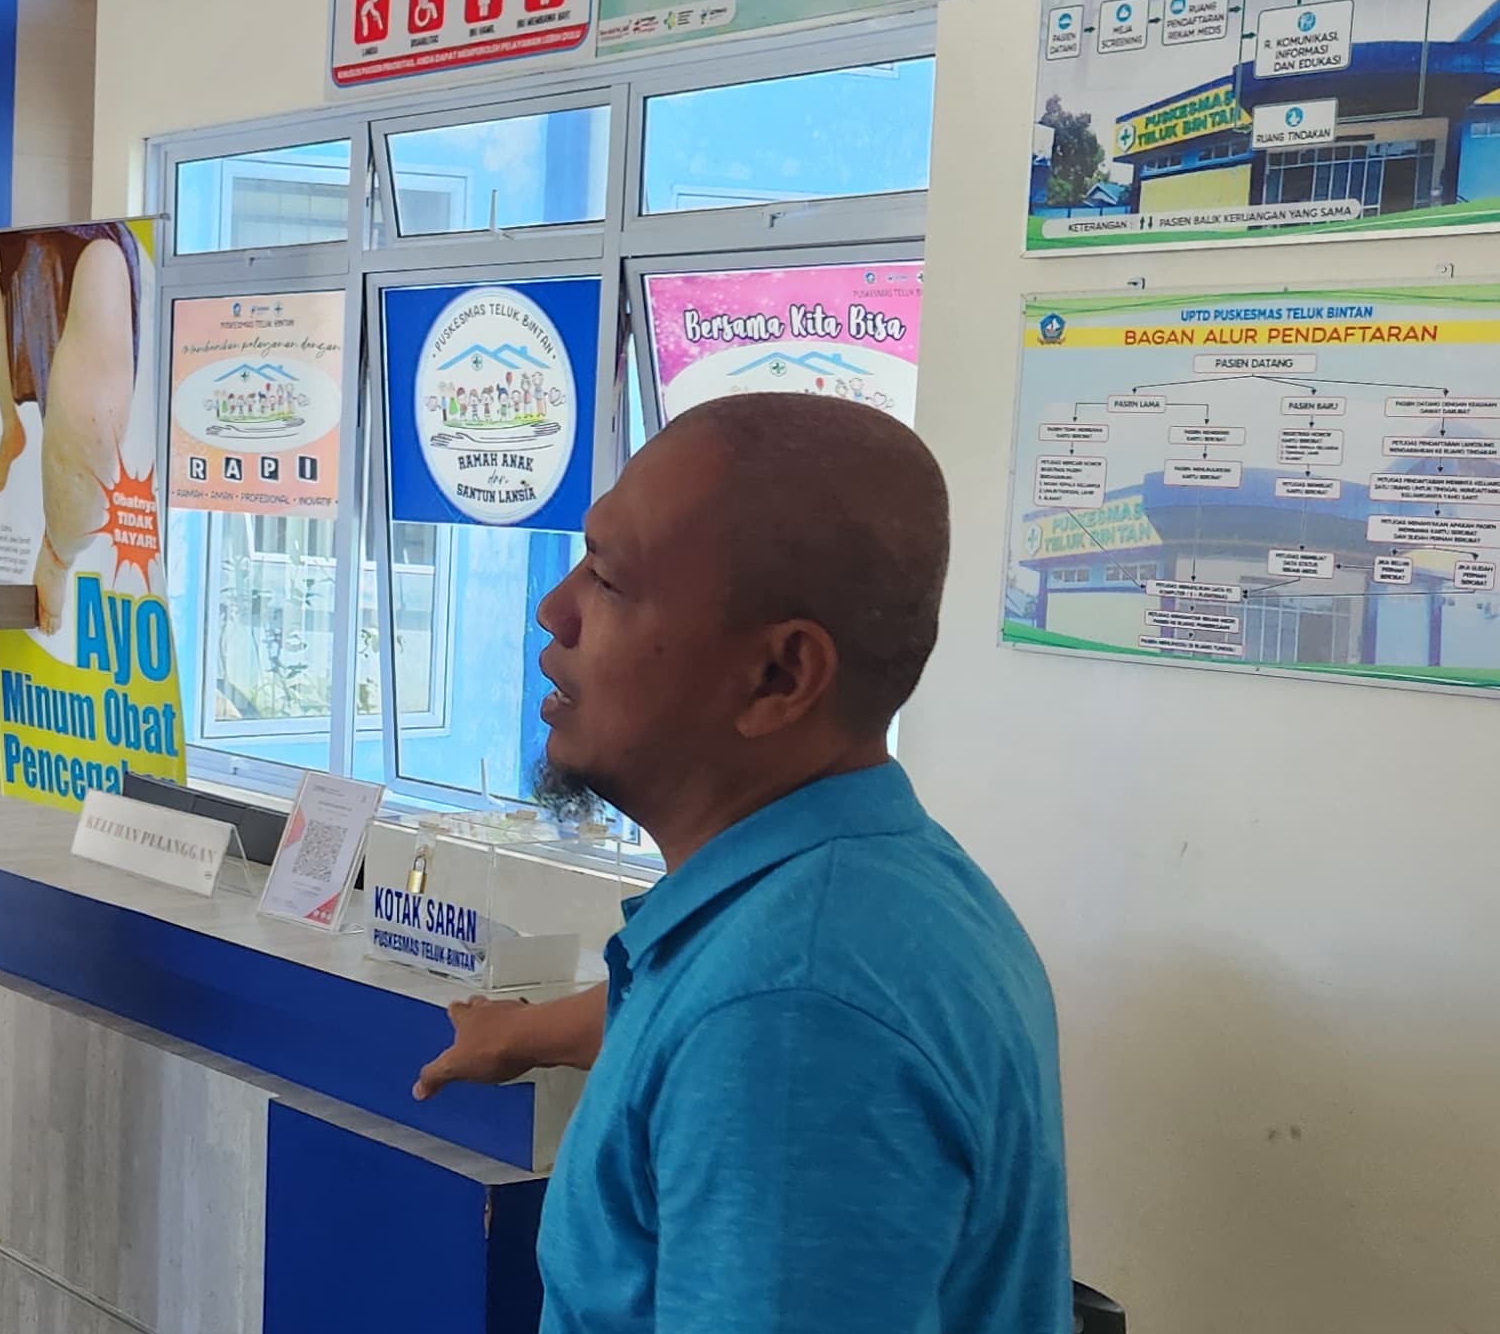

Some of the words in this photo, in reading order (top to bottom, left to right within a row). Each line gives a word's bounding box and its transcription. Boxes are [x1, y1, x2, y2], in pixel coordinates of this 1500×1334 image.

[1275, 45, 1329, 59] INFORMASI
[1273, 61, 1296, 73] DAN
[1299, 55, 1342, 69] EDUKASI
[1256, 132, 1285, 143] RUANG
[1288, 129, 1331, 141] TINDAKAN
[1068, 220, 1128, 233] KETERANGAN
[1159, 216, 1191, 228] PASIEN
[1222, 210, 1286, 225] KERUANGAN
[1288, 208, 1318, 220] YANG
[1319, 206, 1352, 219] SAMA
[684, 307, 784, 343] Bersama
[789, 303, 842, 339] Kita
[849, 304, 906, 341] Bisa
[1181, 310, 1210, 322] UPTD
[1214, 308, 1283, 321] PUSKESMAS
[1286, 306, 1324, 319] TELUK
[1327, 306, 1373, 318] BINTAN
[434, 304, 486, 353] PUSKESMAS
[489, 303, 520, 322] TELUK
[522, 315, 554, 355] BINTAN
[1124, 329, 1194, 346] BAGAN
[1203, 328, 1257, 345] ALUR
[1267, 325, 1438, 344] PENDAFTARAN
[1215, 359, 1249, 369] PASIEN
[1251, 358, 1293, 369] DATANG
[458, 453, 498, 470] RAMAH
[501, 453, 534, 472] ANAK
[457, 483, 496, 503] SANTUN
[499, 487, 536, 503] LANSIA
[116, 510, 153, 530] TIDAK
[113, 528, 158, 549] BAYAR!
[75, 574, 172, 686] Ayo
[1, 669, 96, 741] Minum
[104, 689, 179, 757] Obat
[84, 816, 140, 844] KELUHAN
[140, 831, 218, 864] PELANGGAN
[374, 886, 423, 930] KOTAK
[426, 899, 477, 944] SARAN
[374, 929, 420, 957] PUSKESMAS
[421, 941, 445, 964] TELUK
[448, 948, 476, 972] BINTAN
